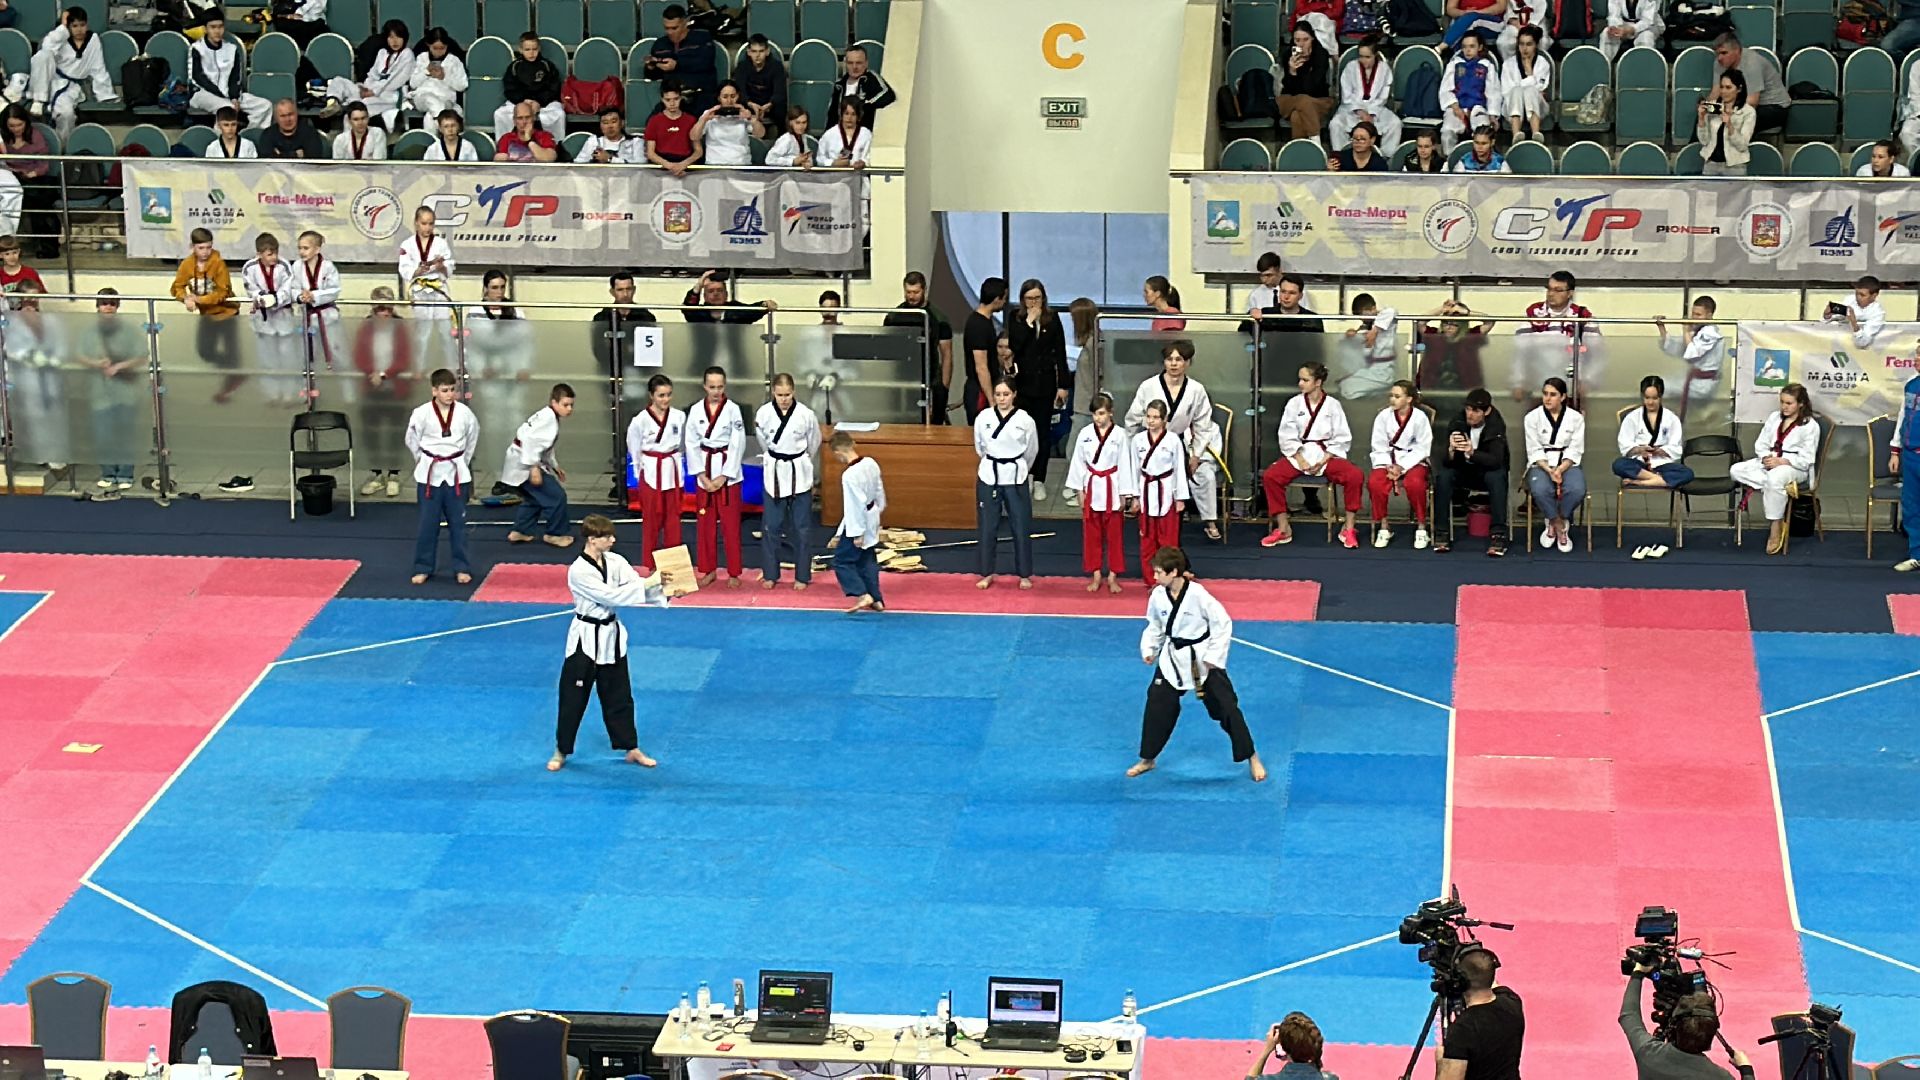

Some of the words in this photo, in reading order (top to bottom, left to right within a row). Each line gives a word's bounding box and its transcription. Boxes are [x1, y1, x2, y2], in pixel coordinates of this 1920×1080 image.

[1041, 22, 1087, 70] C
[1048, 102, 1080, 113] EXIT
[1047, 119, 1078, 128] ВЫХОД
[257, 192, 335, 207] Гепа-Мерц
[188, 207, 245, 218] MAGMA
[1327, 205, 1408, 220] Гепа-Мерц
[1256, 220, 1314, 231] MAGMA
[1491, 246, 1522, 254] СОЮЗ
[1596, 248, 1639, 256] РОССИИ
[645, 335, 655, 348] 5
[1807, 371, 1870, 383] MAGMA
[1820, 382, 1857, 390] GROUP
